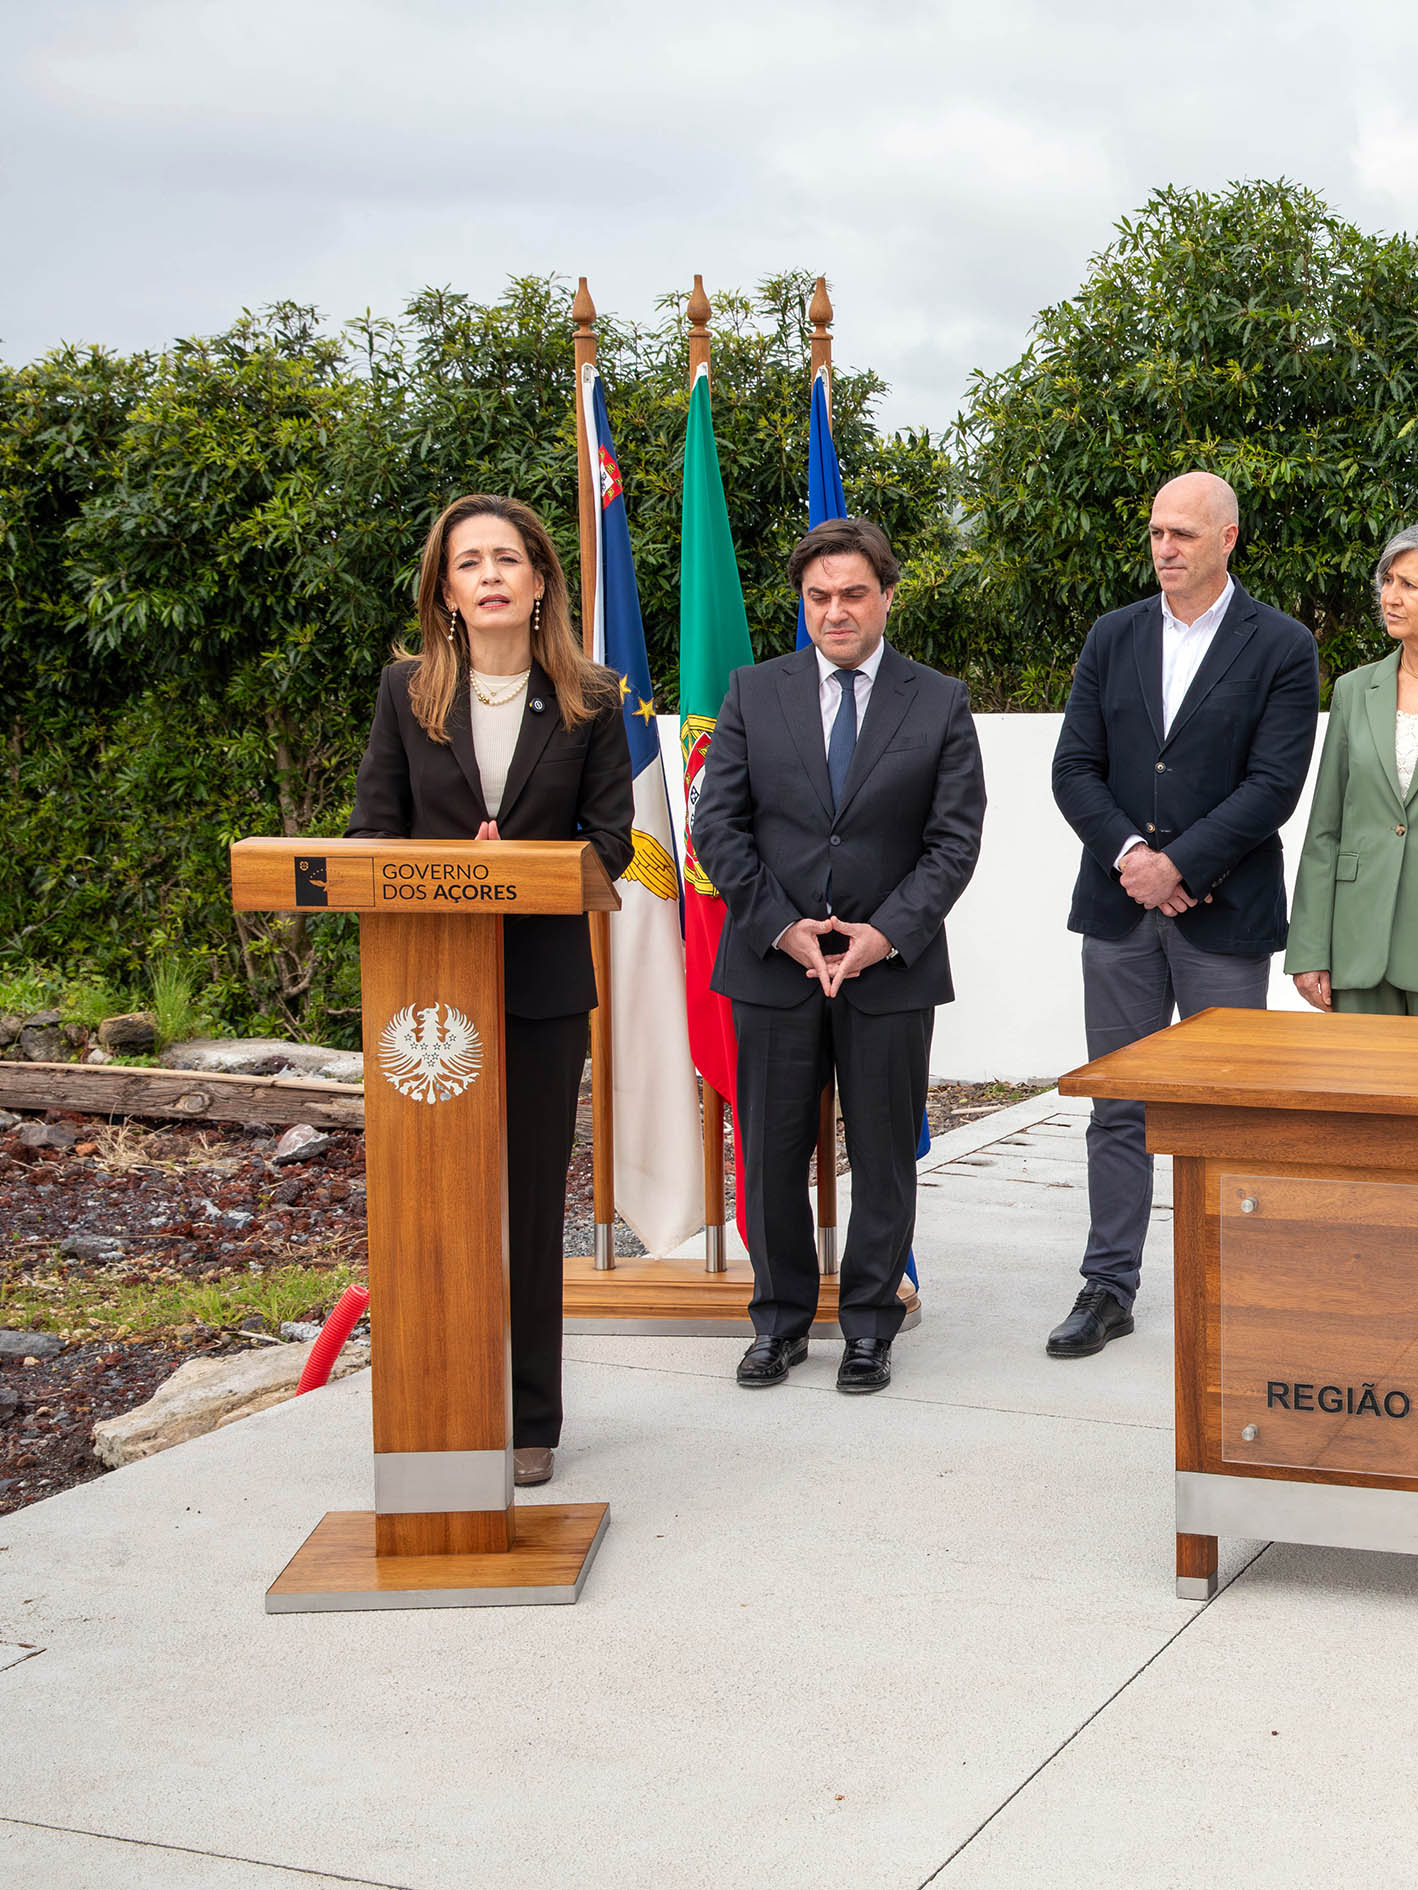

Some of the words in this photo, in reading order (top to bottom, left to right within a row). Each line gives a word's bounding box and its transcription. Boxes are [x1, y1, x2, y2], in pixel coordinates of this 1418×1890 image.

[383, 864, 489, 880] GOVERNO
[383, 884, 427, 899] DOS
[433, 884, 517, 903] AÇORES
[1267, 1381, 1411, 1419] REGIÃO
